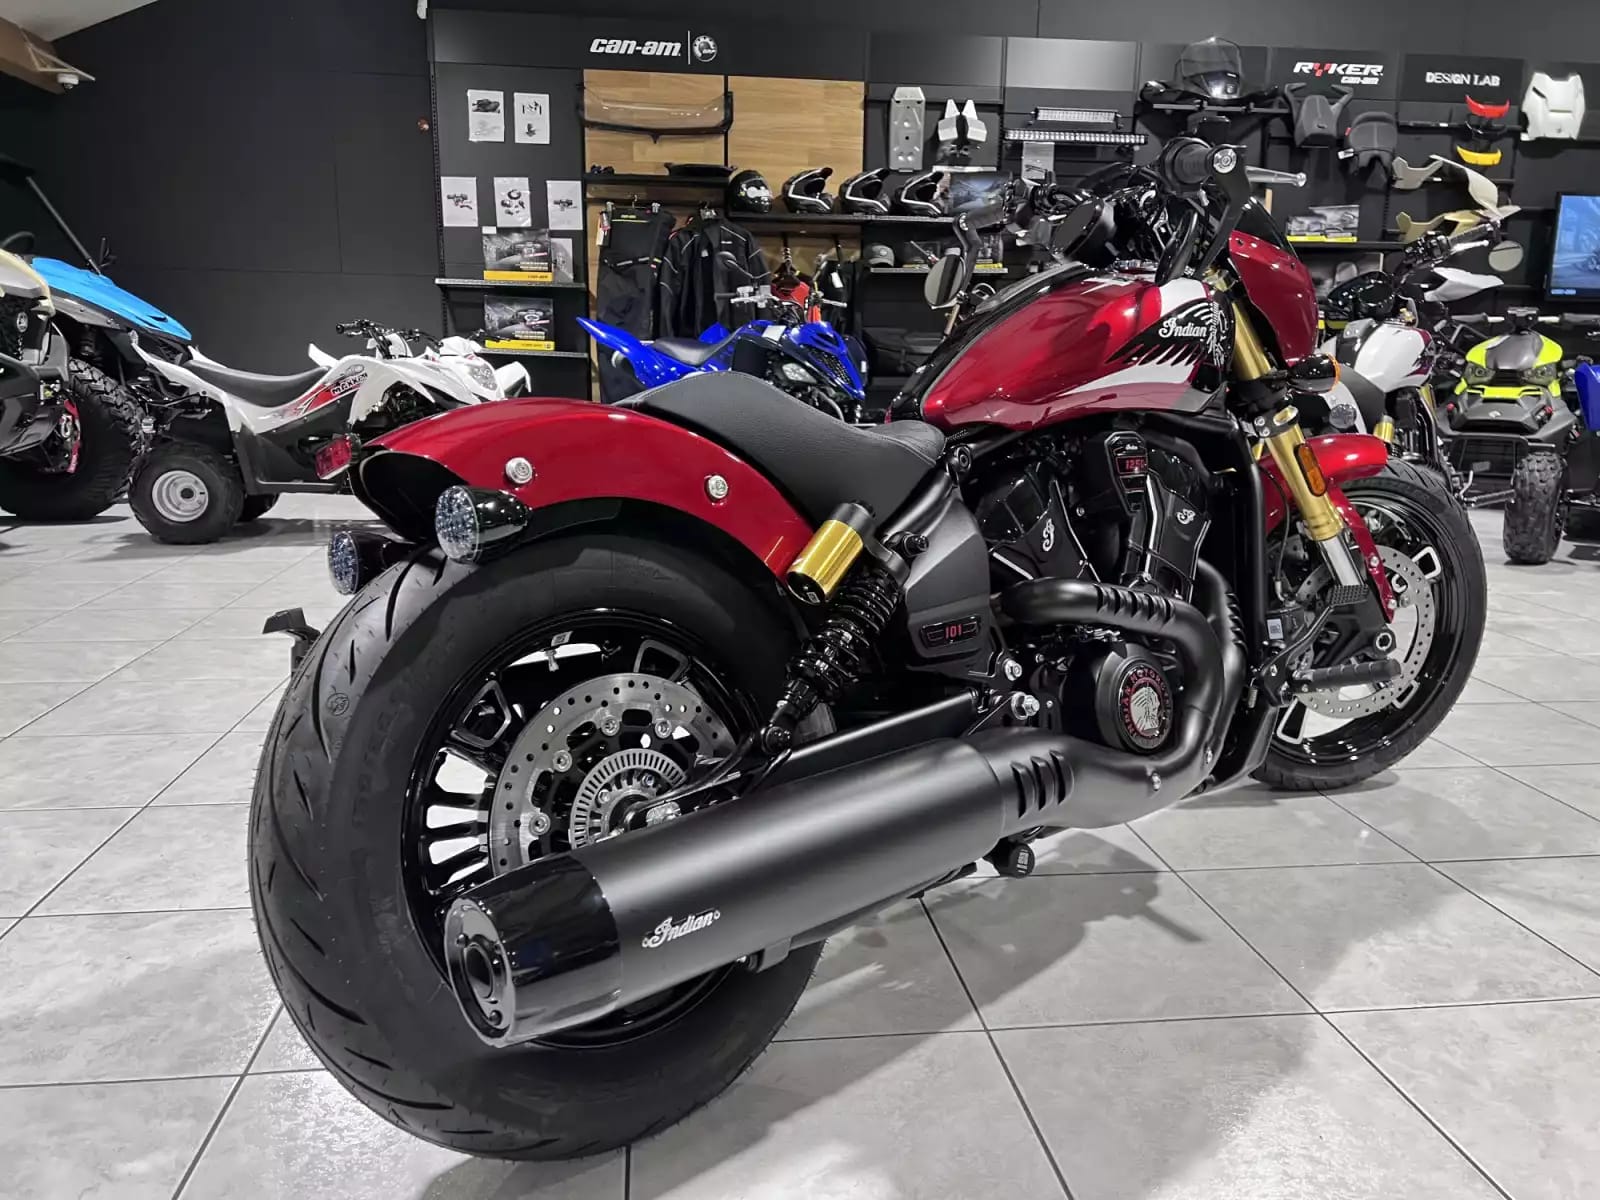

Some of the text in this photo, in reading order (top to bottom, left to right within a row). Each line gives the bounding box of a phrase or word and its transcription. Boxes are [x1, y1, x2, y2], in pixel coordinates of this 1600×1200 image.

[590, 38, 682, 57] can-am
[1293, 61, 1384, 77] RYKER
[1425, 71, 1501, 87] DESIGN LAB
[1158, 317, 1208, 338] Indian
[945, 624, 962, 639] 101
[648, 911, 714, 949] Indian
